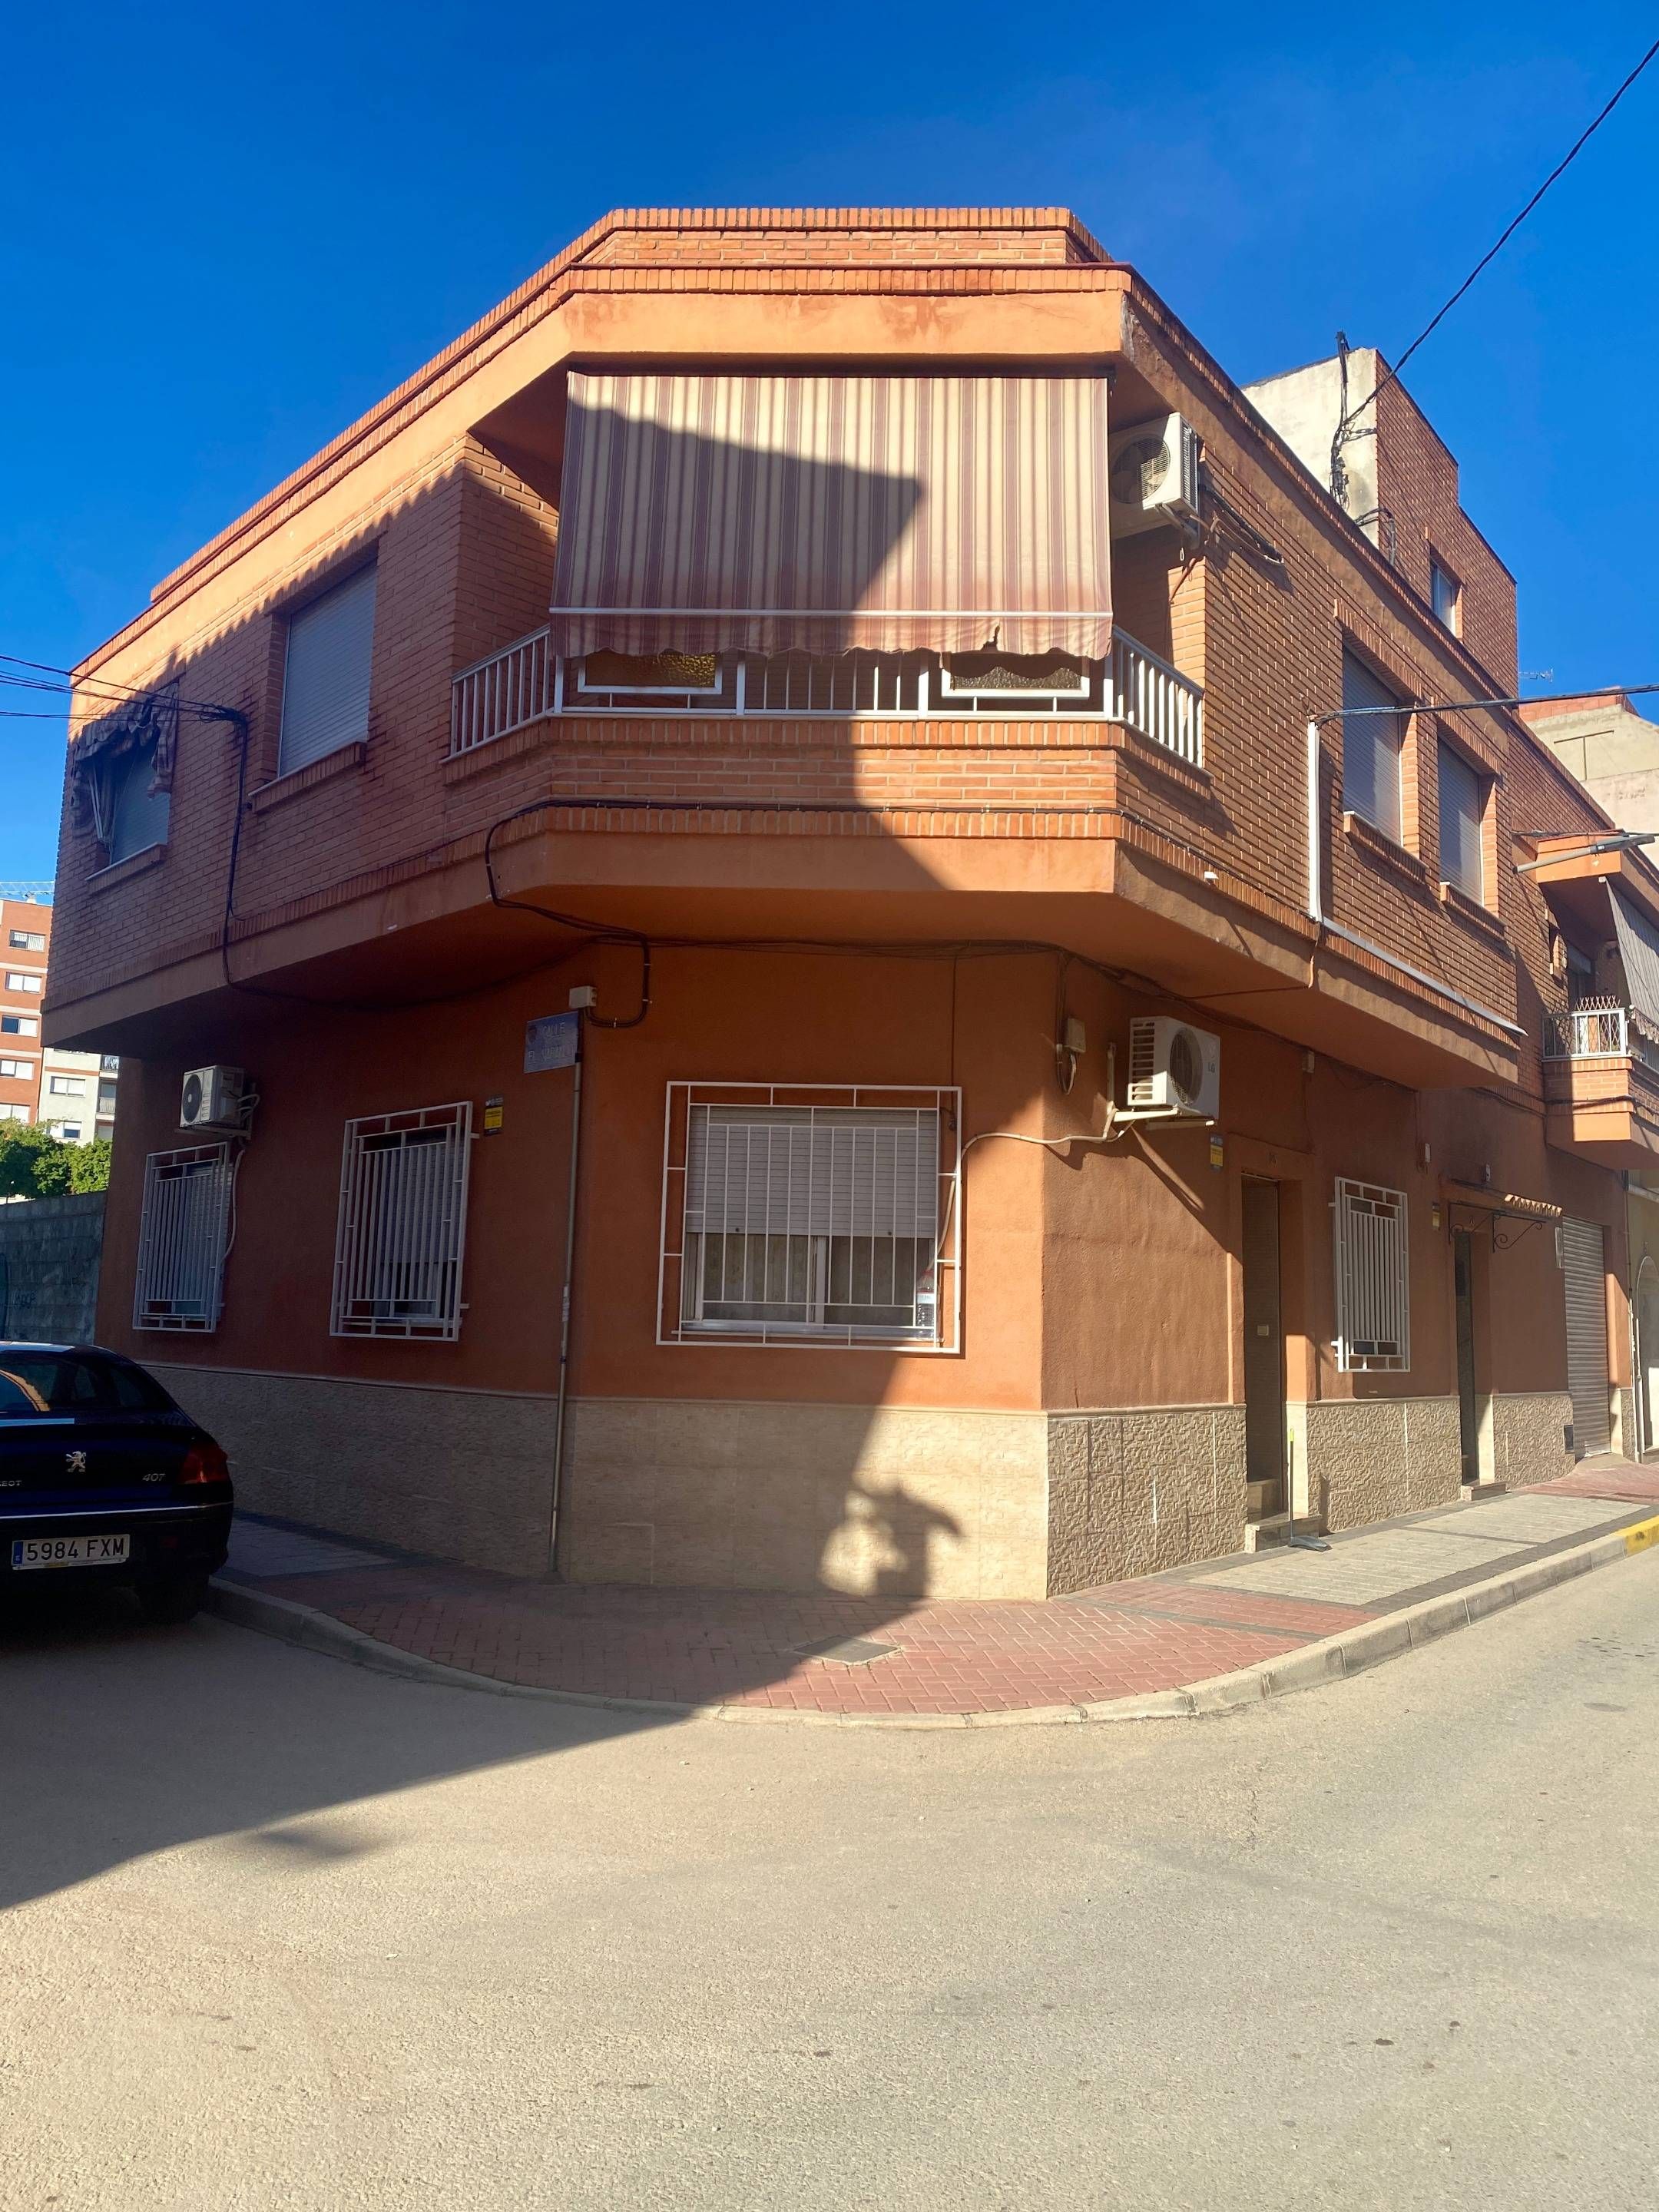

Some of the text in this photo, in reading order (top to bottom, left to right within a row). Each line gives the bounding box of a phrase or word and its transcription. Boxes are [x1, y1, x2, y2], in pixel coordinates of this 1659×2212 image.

[142, 1473, 166, 1482] 407
[27, 1538, 124, 1561] 5984 FXM
